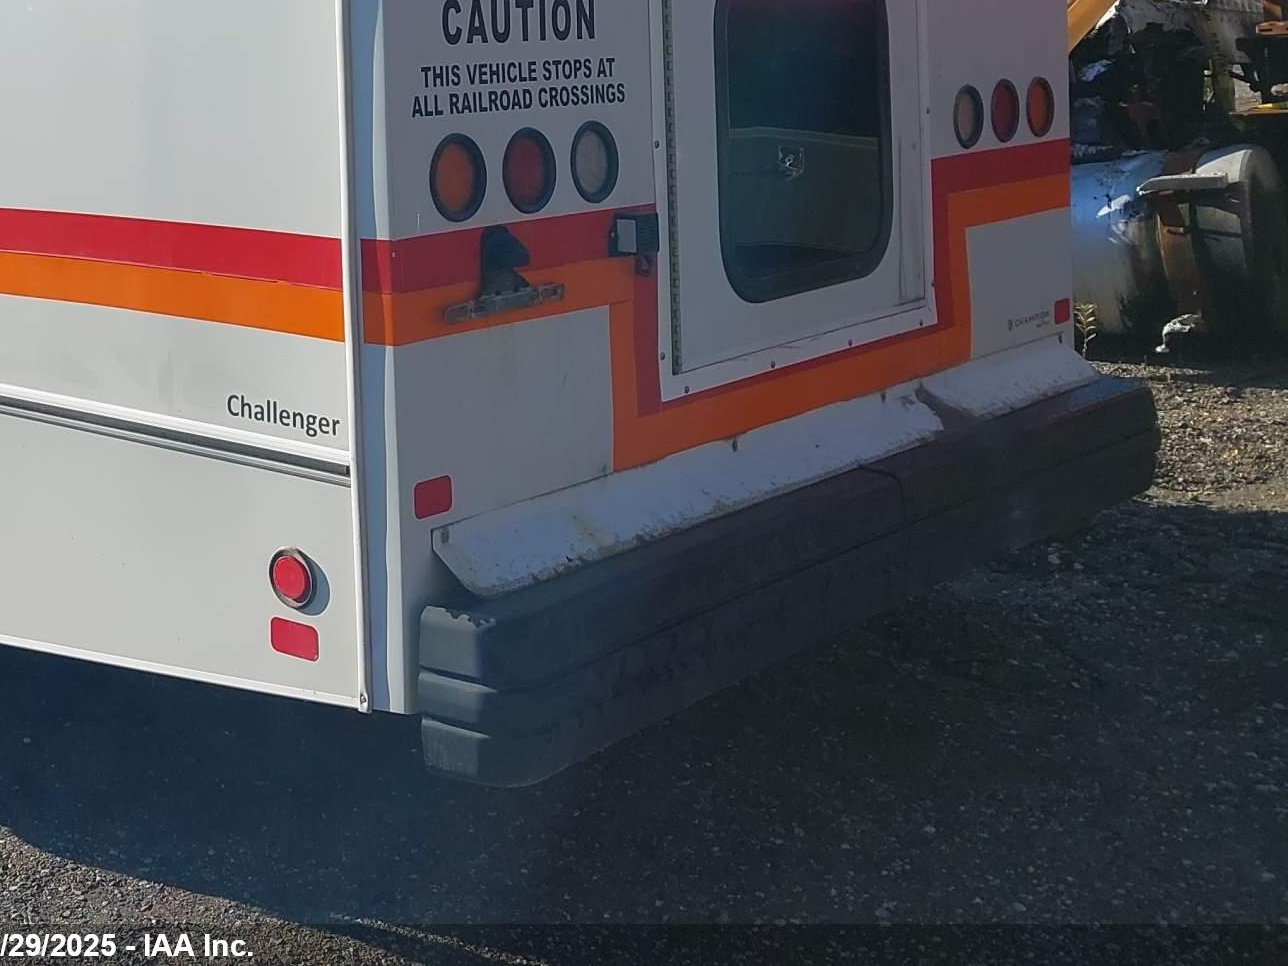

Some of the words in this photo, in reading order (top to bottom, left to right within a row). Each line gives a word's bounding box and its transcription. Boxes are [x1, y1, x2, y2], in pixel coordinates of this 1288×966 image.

[421, 65, 461, 88] THIS
[466, 61, 538, 85] VEHICLE
[542, 58, 592, 82] STOPS
[597, 57, 616, 78] AT
[412, 95, 444, 119] ALL
[449, 88, 533, 115] RAILROAD
[538, 83, 626, 109] CROSSINGS
[226, 394, 341, 438] Challenger
